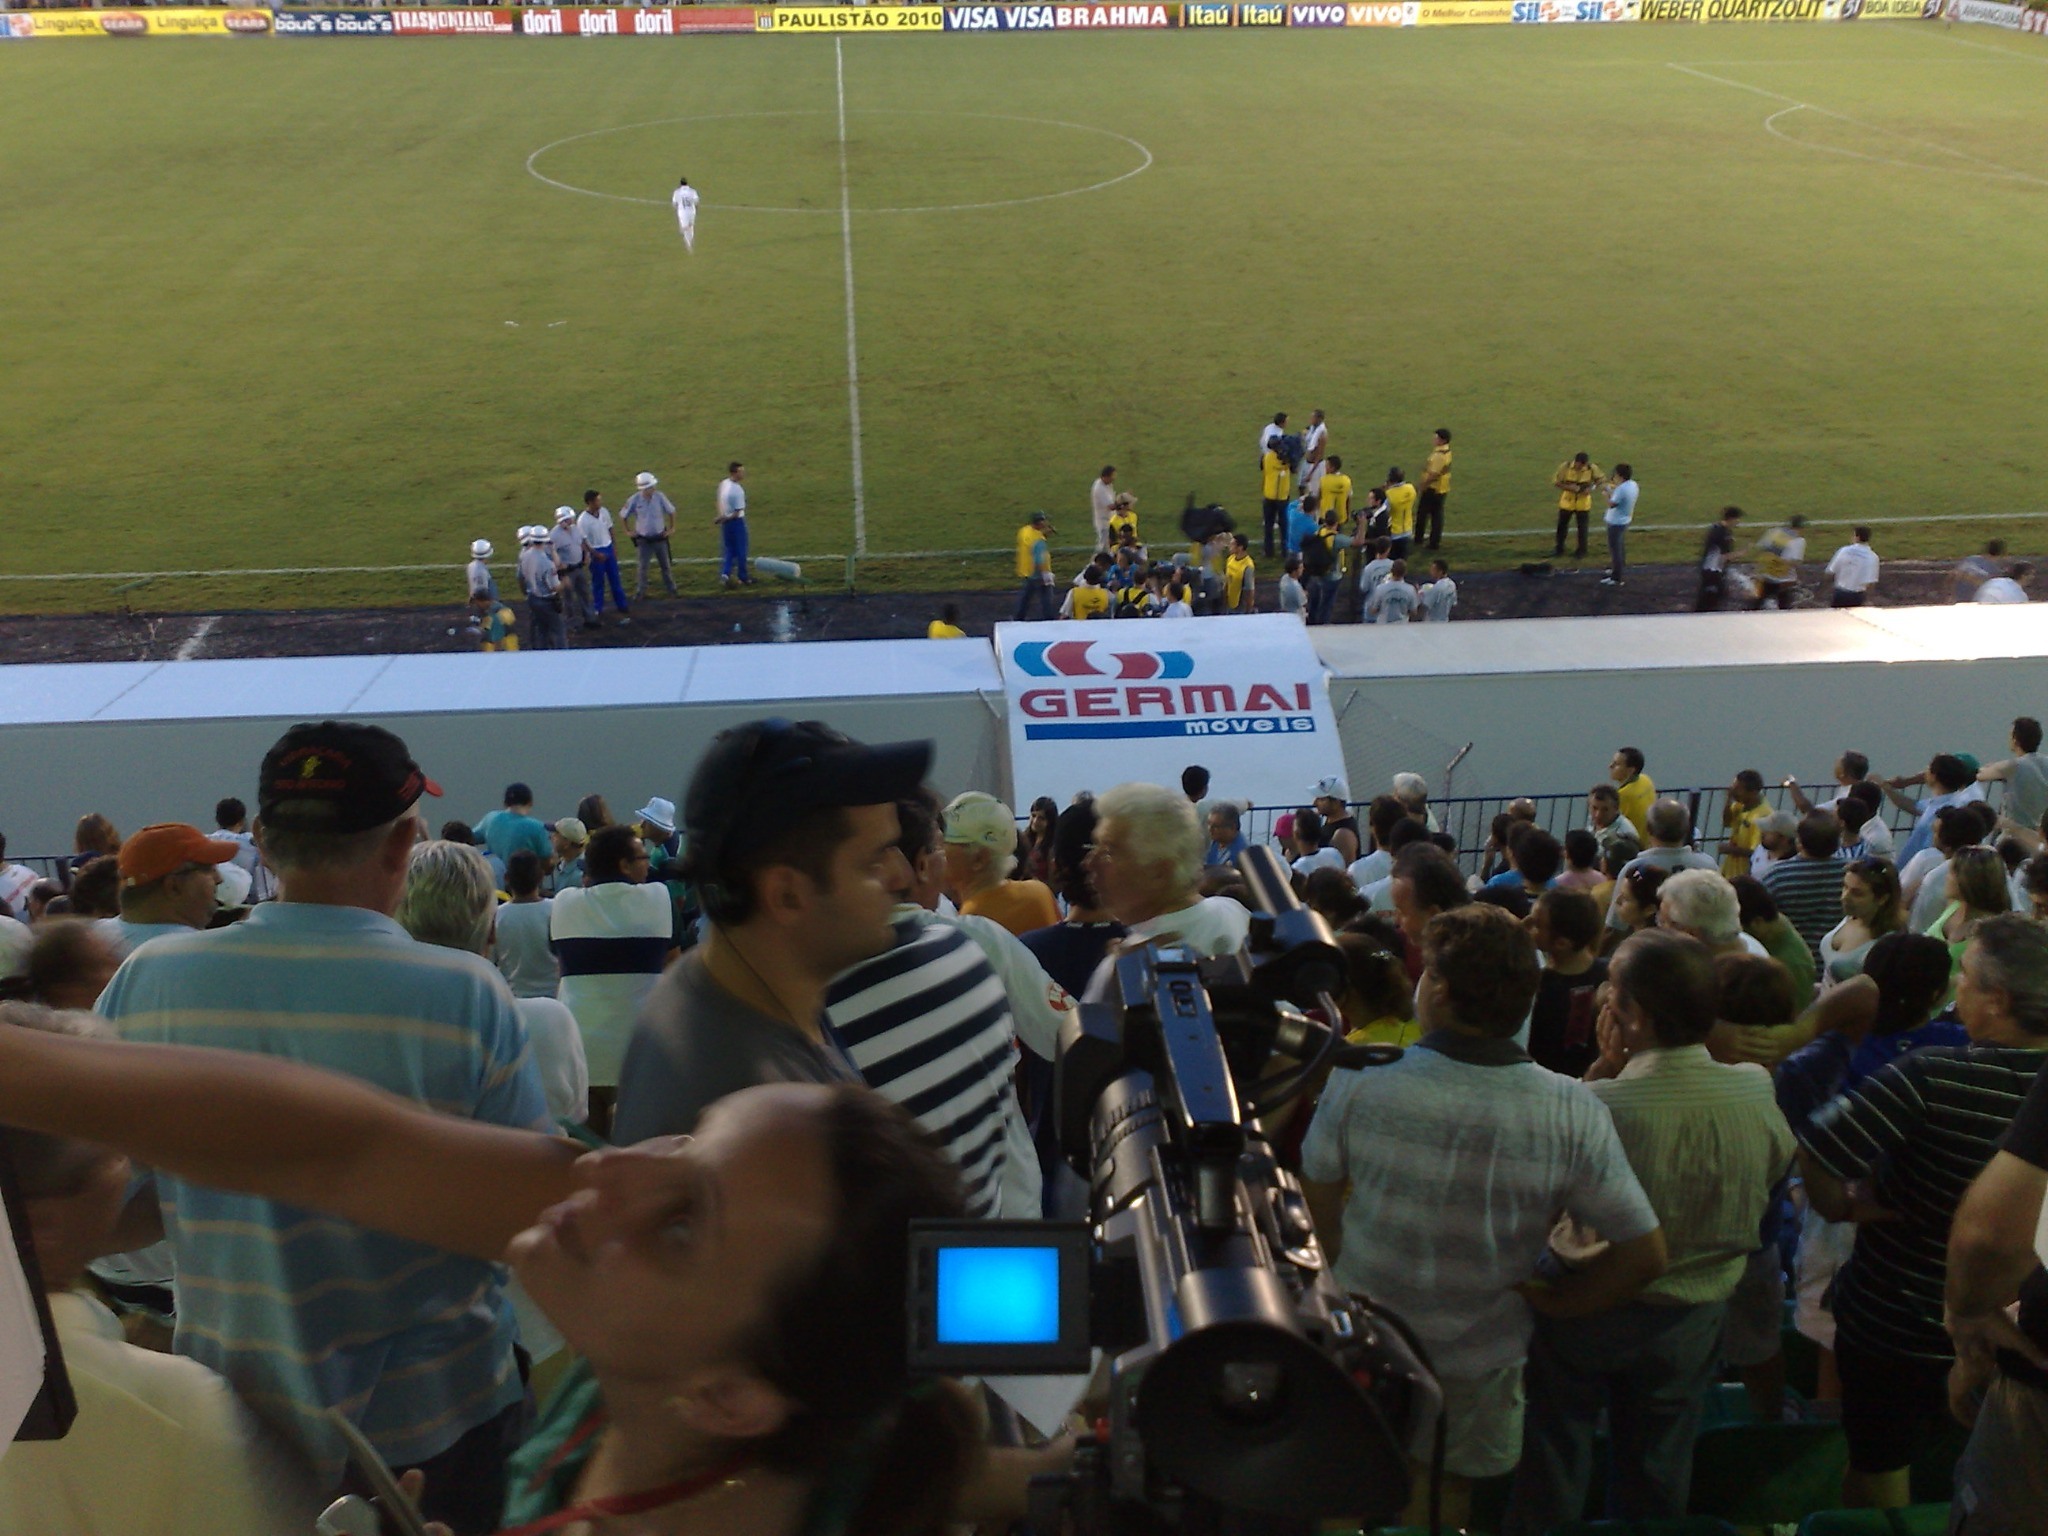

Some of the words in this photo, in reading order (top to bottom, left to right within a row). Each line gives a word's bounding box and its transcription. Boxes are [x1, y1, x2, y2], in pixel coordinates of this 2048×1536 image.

[778, 10, 889, 27] PAULISTÃO
[897, 12, 942, 26] 2010
[949, 7, 999, 29] VISA
[1003, 6, 1054, 27] VISA
[1057, 6, 1168, 25] BRAHMA
[1189, 4, 1228, 25] Itaú
[1243, 4, 1282, 24] Itaú
[1640, 0, 1701, 20] WEBER
[1708, 0, 1821, 19] QUARTZOLIT
[35, 17, 94, 31] Linguiça
[157, 16, 217, 29] Linguiça
[392, 11, 495, 31] TRASMONTANO
[523, 9, 562, 33] doril
[579, 9, 617, 33] doril
[635, 9, 673, 33] doril
[1019, 683, 1312, 718] GERMAI
[1185, 716, 1314, 735] móveis
